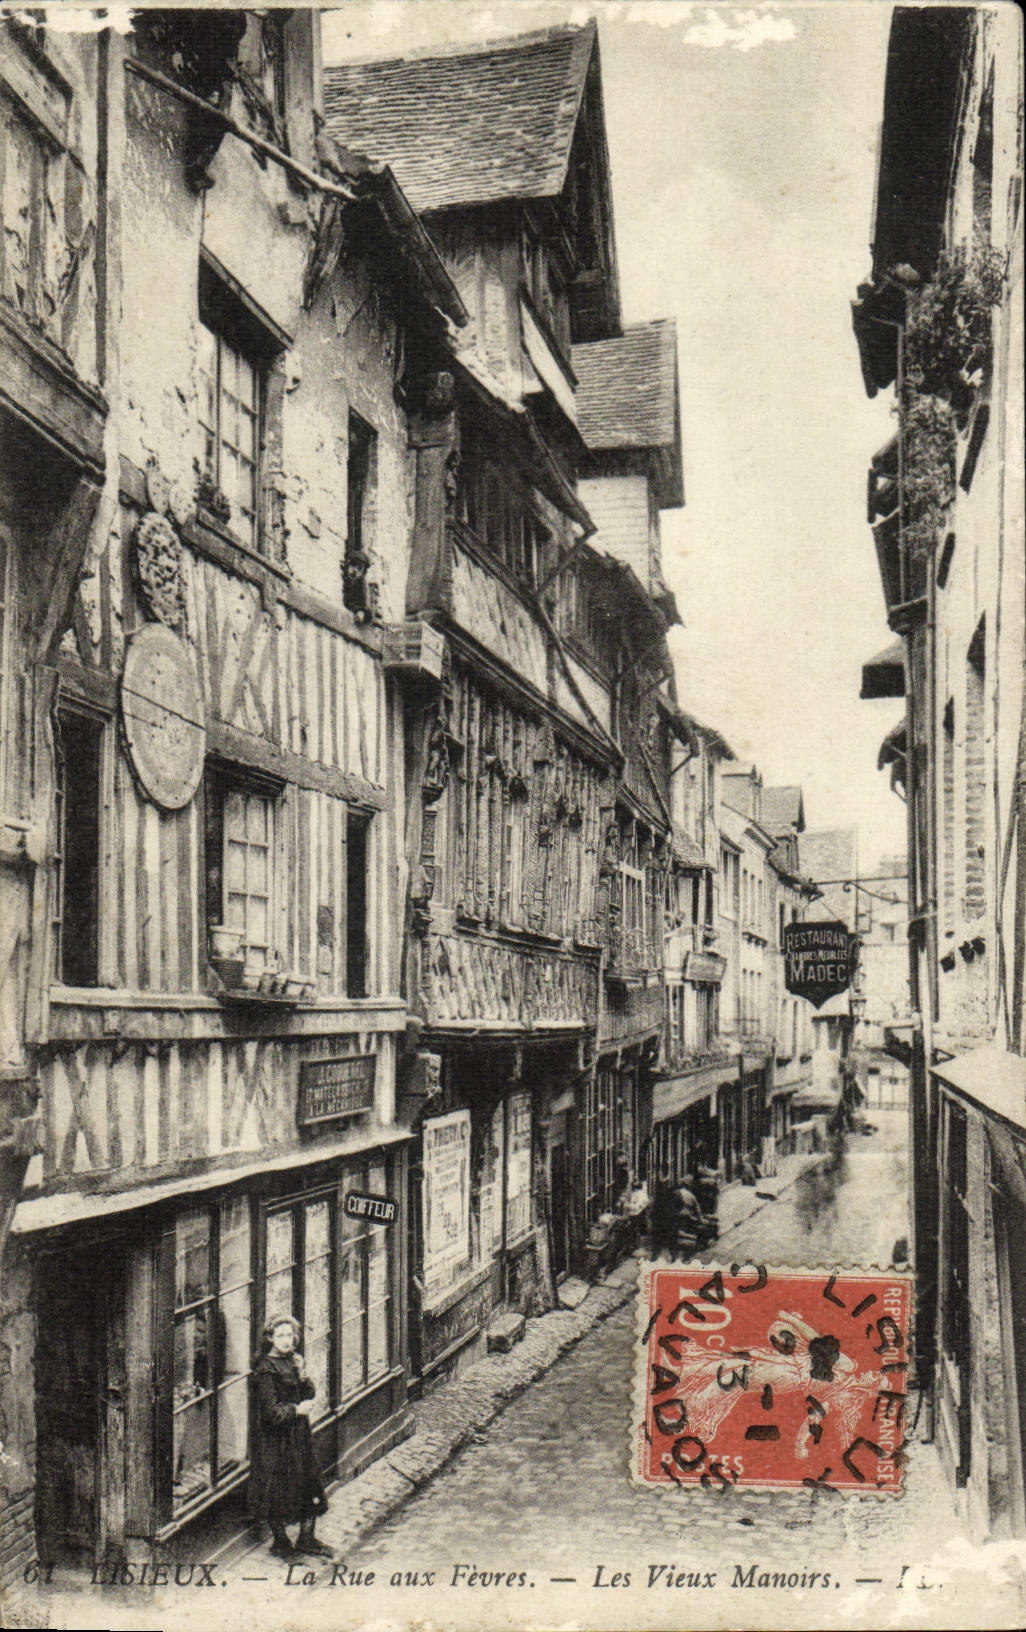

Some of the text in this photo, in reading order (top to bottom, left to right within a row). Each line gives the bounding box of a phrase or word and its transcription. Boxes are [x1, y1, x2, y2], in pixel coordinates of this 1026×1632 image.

[786, 930, 848, 950] RESTAURANT
[790, 960, 847, 983] MADEC
[347, 1195, 395, 1220] COIFFEUR
[679, 1286, 734, 1332] 10
